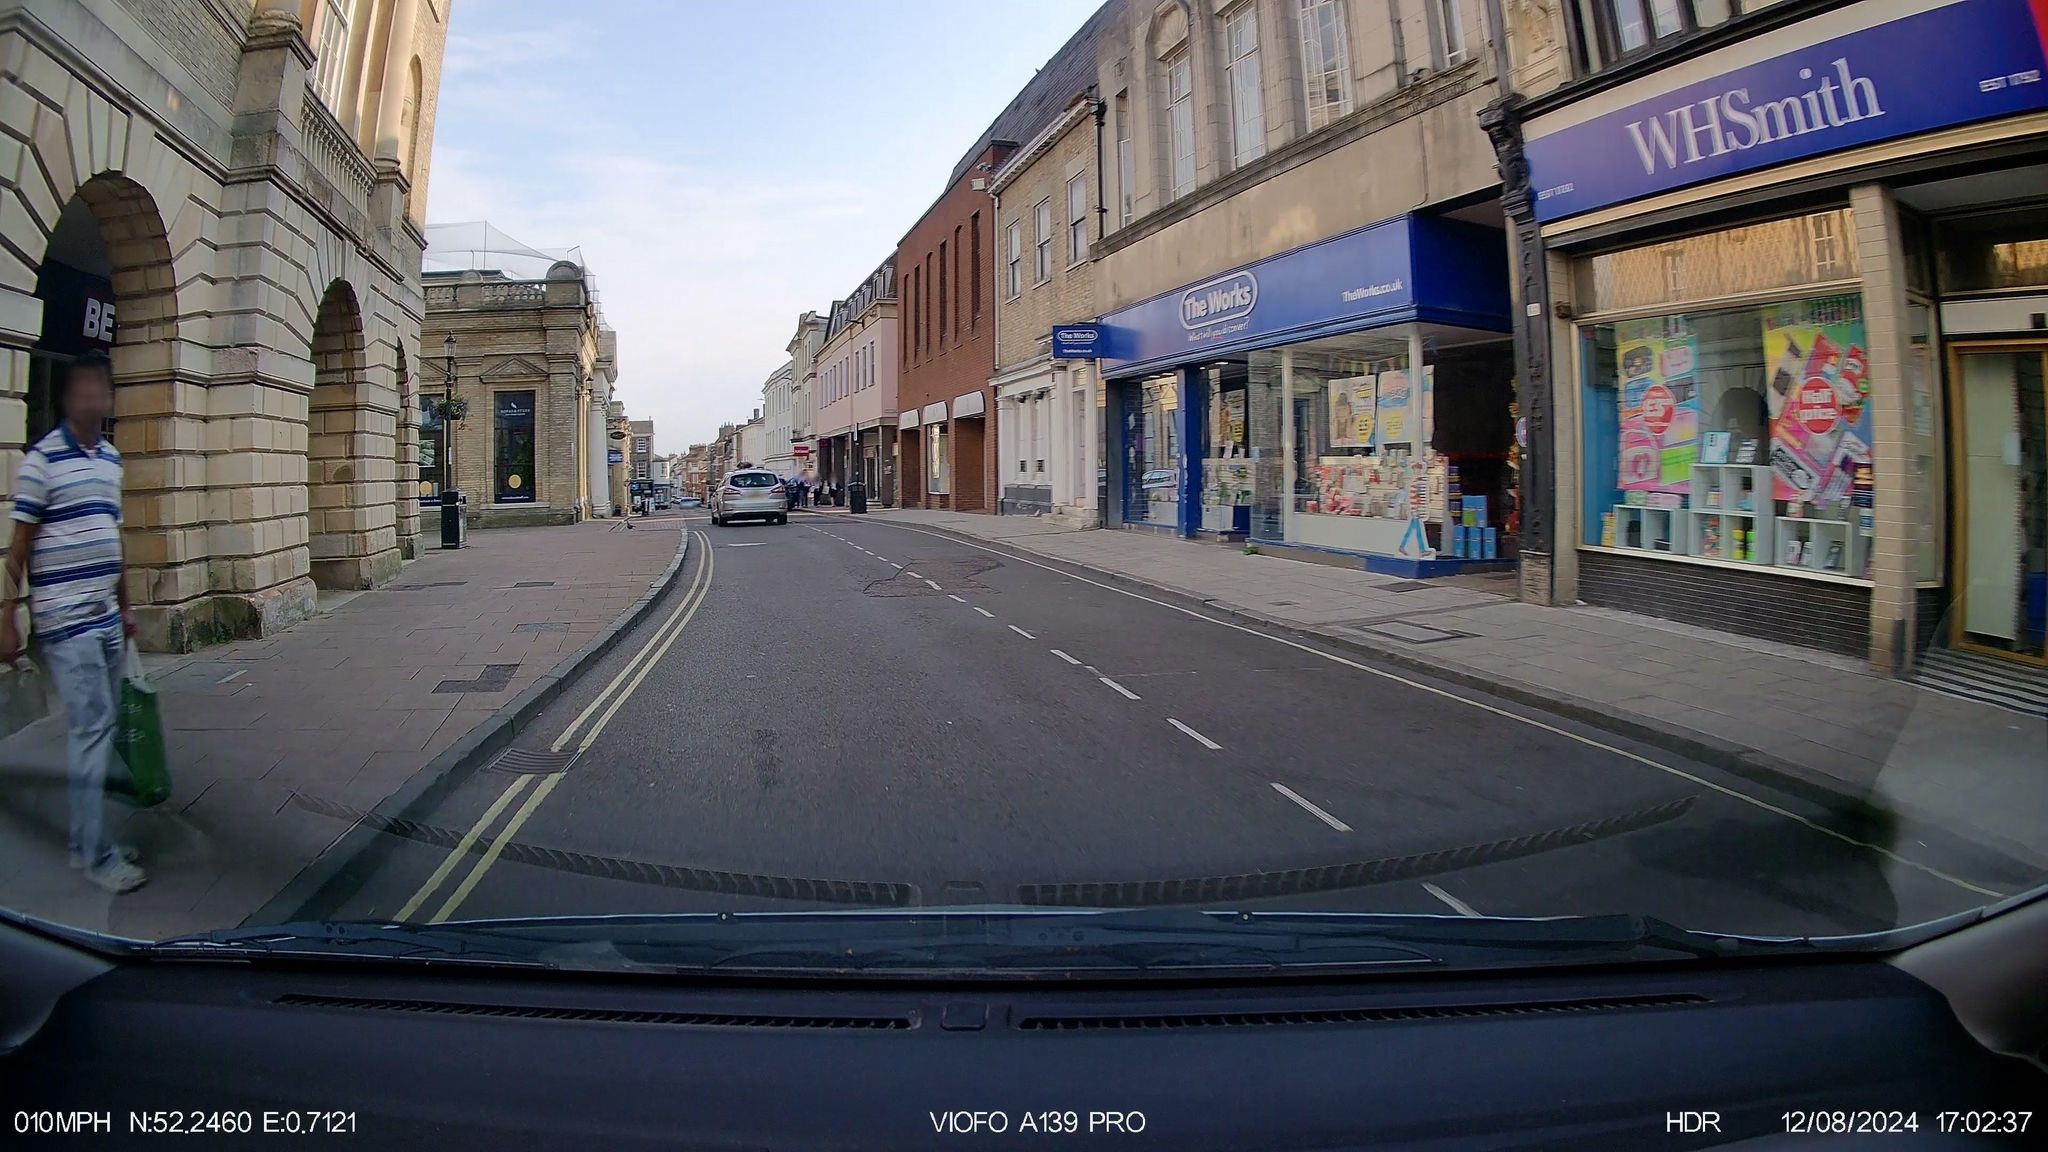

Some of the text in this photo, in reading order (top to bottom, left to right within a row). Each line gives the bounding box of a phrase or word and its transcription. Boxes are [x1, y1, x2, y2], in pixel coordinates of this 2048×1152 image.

[1624, 57, 1886, 175] WHSmith
[1184, 282, 1252, 321] The Works
[1341, 277, 1403, 303] TheWorks.co.uk
[82, 297, 116, 343] BE
